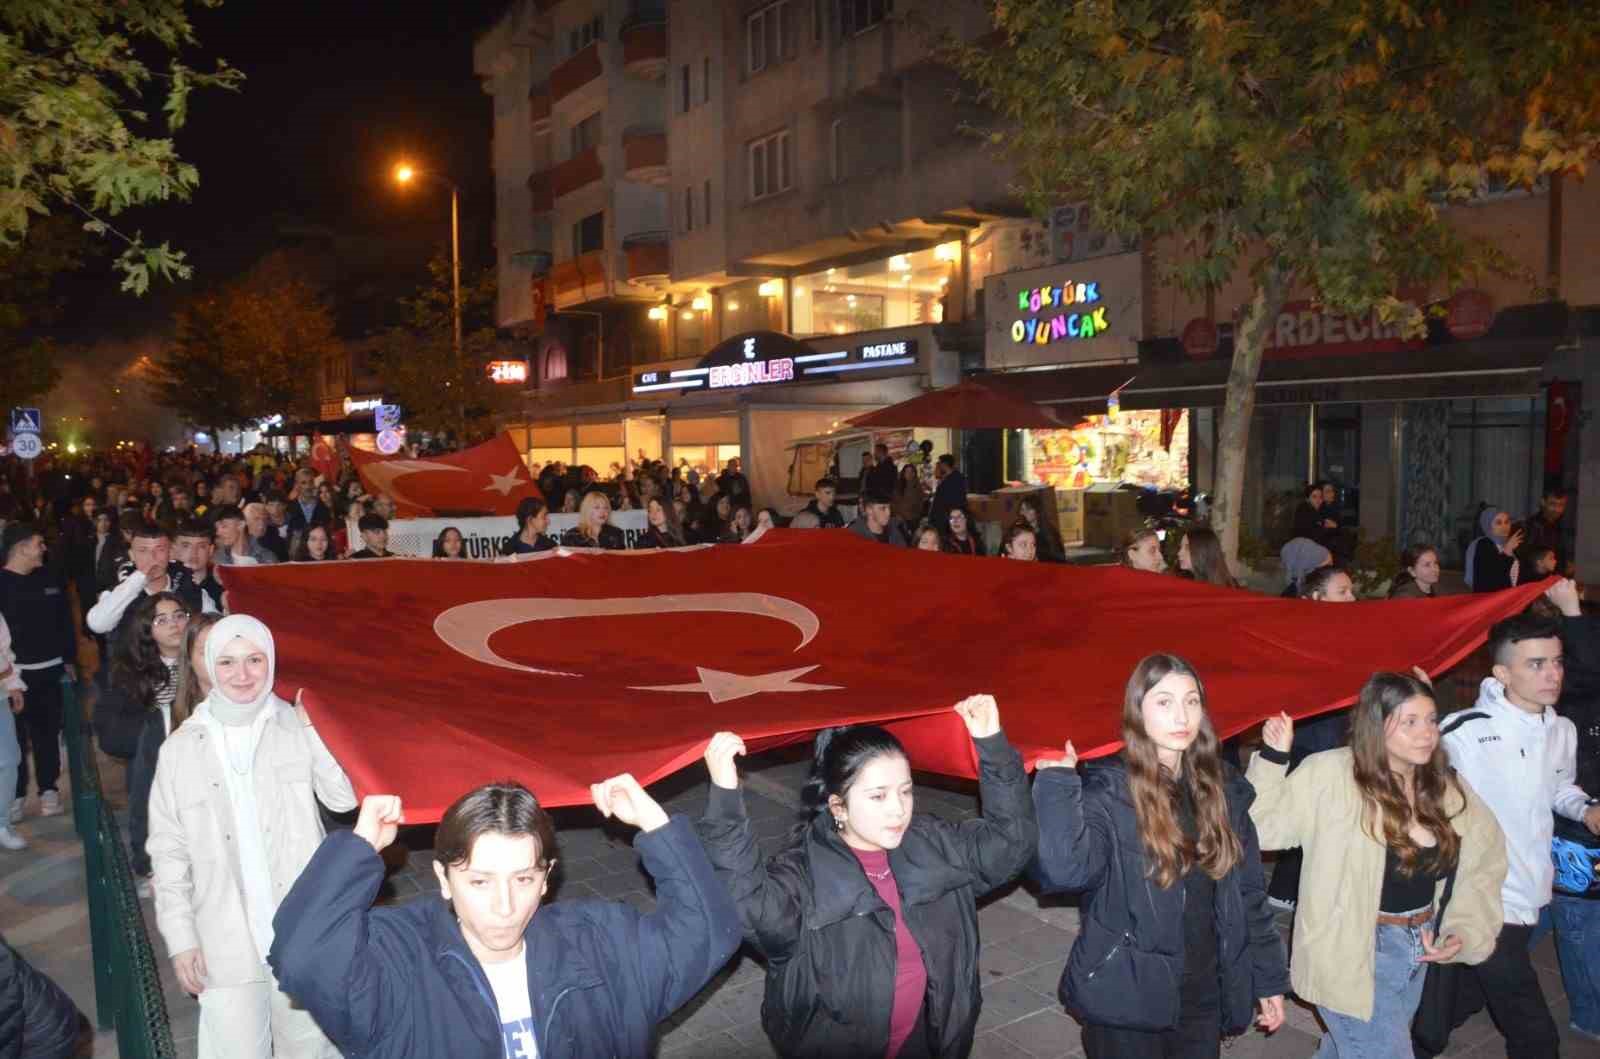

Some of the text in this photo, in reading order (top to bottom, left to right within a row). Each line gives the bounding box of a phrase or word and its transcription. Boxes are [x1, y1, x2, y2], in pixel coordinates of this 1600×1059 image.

[1018, 280, 1099, 312] KÖKTÜRK
[1011, 306, 1107, 345] OYUNCAK
[863, 341, 907, 359] PASTANE
[19, 439, 36, 451] 30
